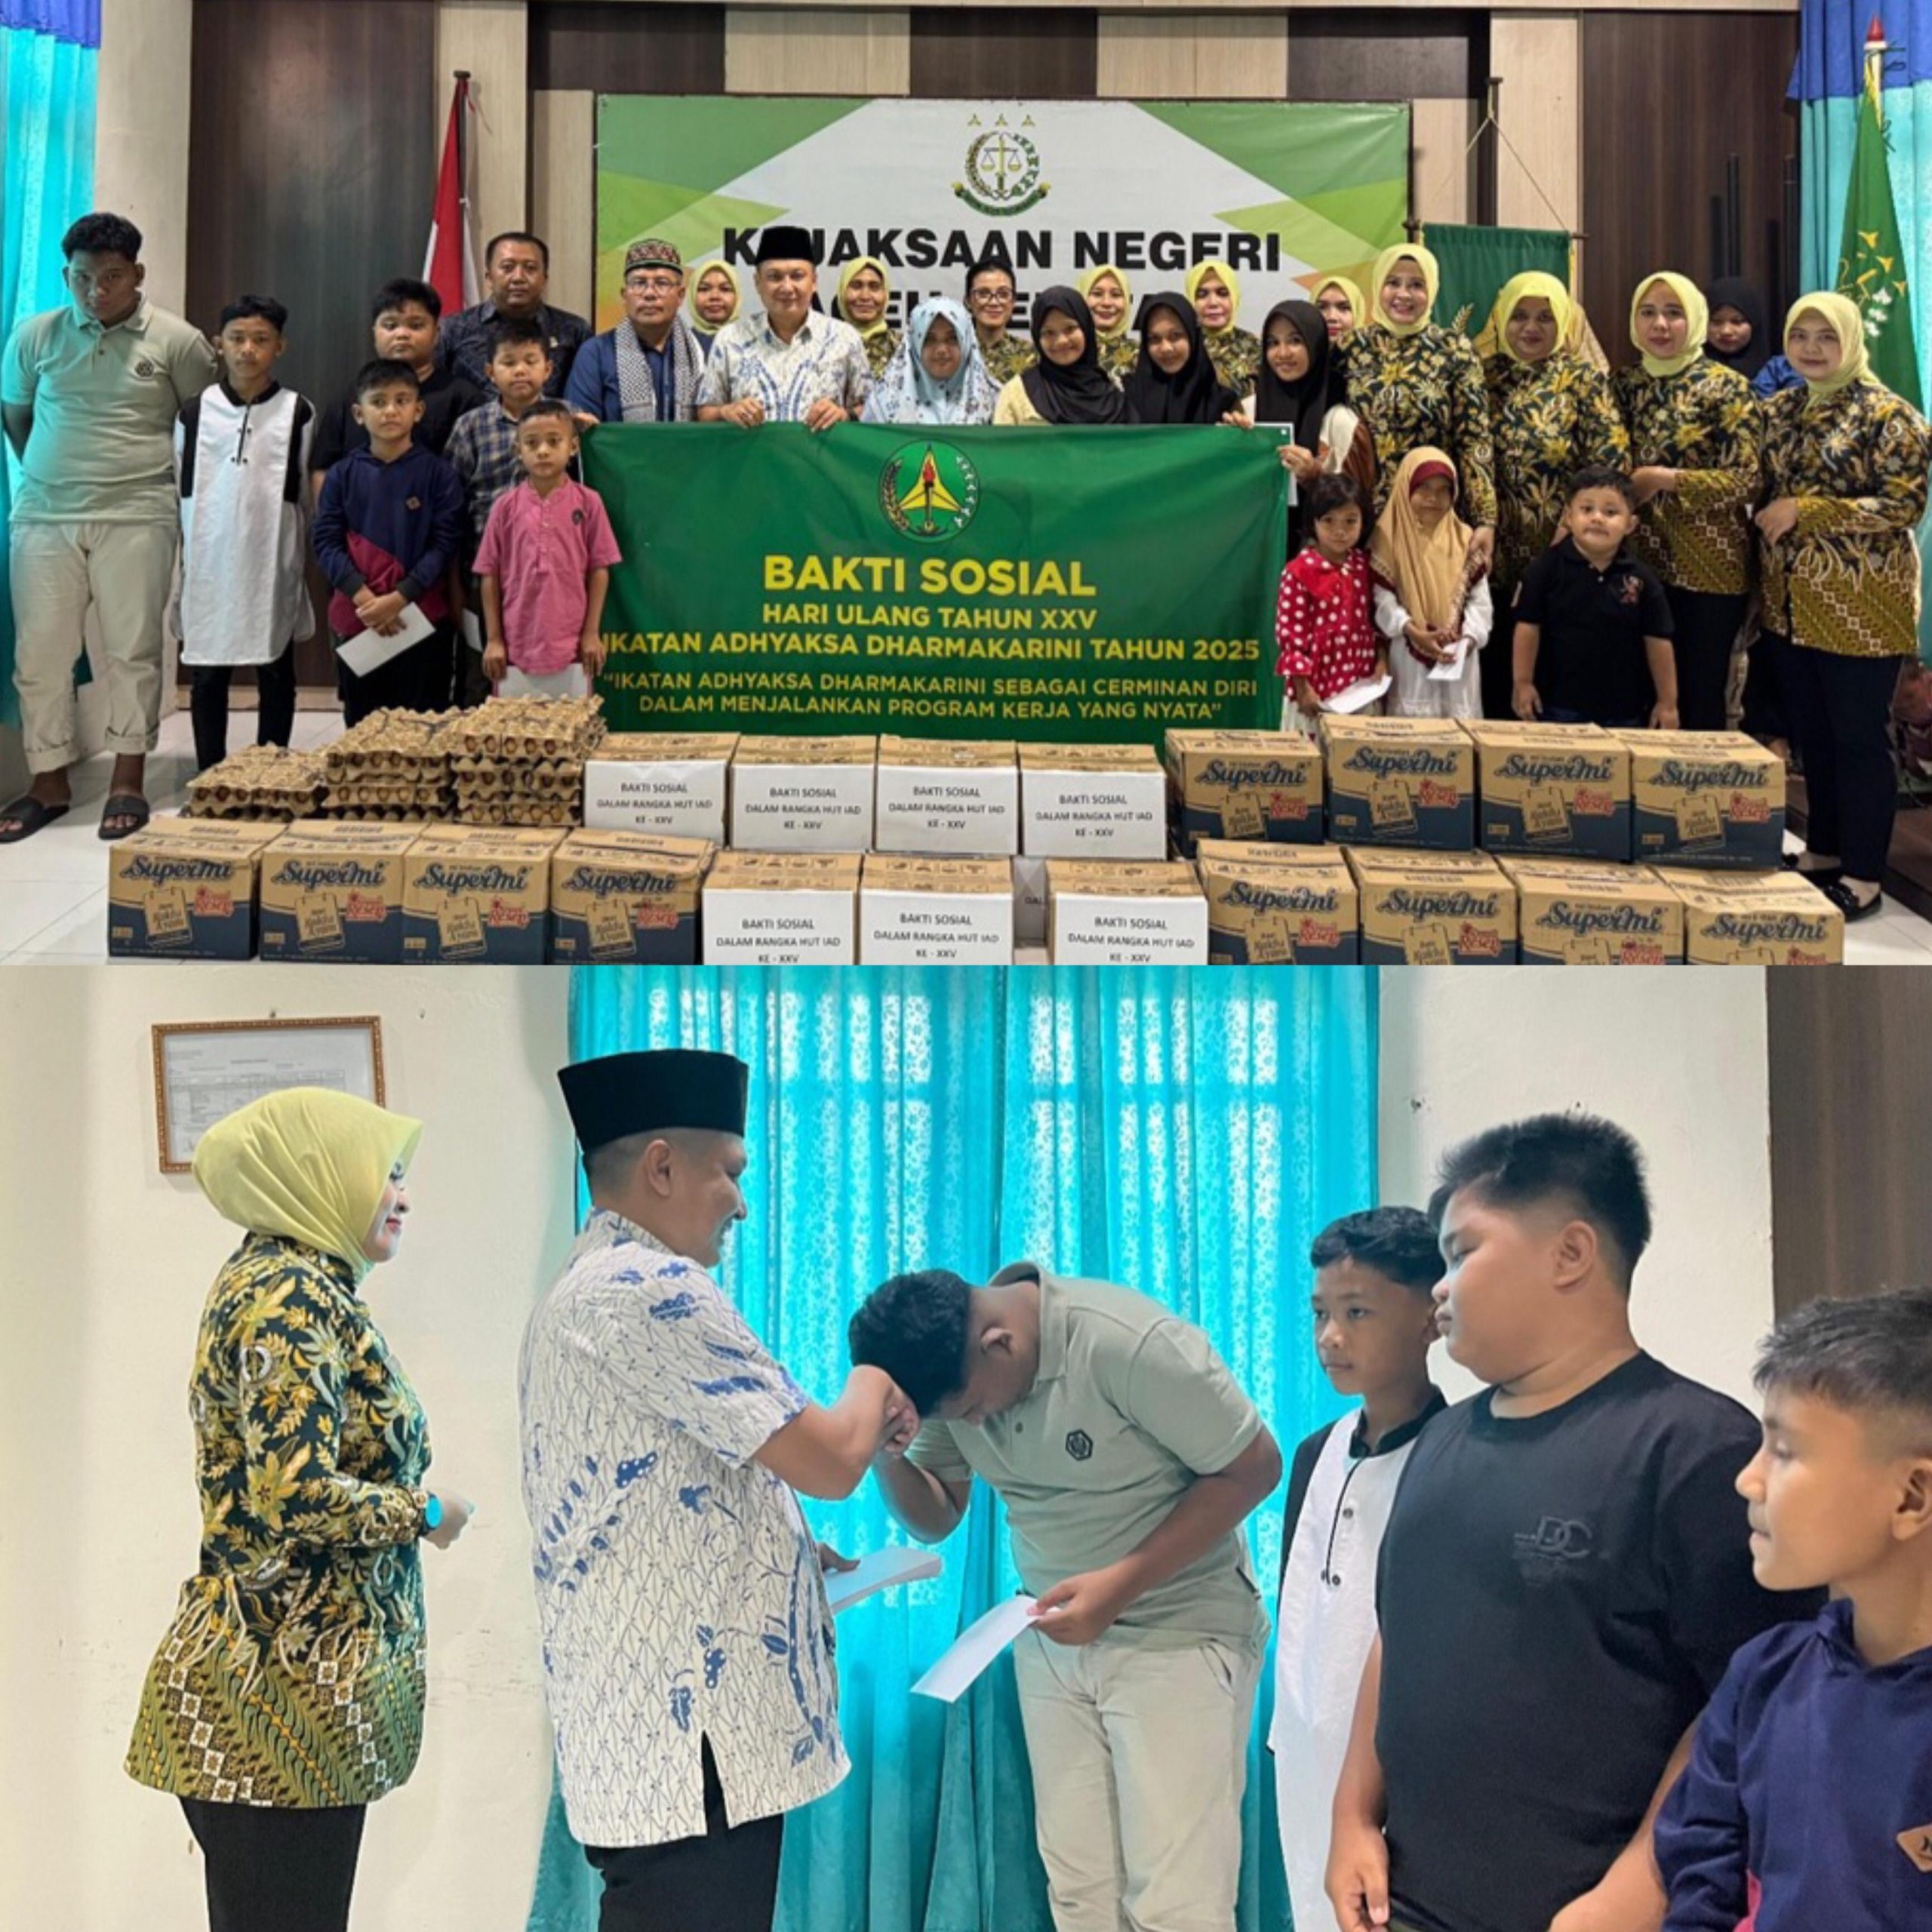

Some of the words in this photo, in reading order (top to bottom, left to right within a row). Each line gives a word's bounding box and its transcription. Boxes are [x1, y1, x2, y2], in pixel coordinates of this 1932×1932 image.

[724, 228, 1052, 268] KJAKSAAN
[1075, 231, 1280, 271] NEGERI
[764, 555, 905, 592] BAKTI
[919, 558, 1097, 596] SOSIAL
[763, 603, 828, 624] HARI
[837, 605, 930, 628] ULANG
[938, 608, 1032, 629] TAHUN
[1040, 609, 1097, 630] XXV
[603, 632, 701, 654] IKATAN
[709, 633, 858, 654] ADHYAKSA
[866, 636, 1081, 660] DHARMAKARINI
[1091, 639, 1185, 660] TAHUN
[1192, 639, 1260, 660] 2025
[698, 673, 813, 691] ADHYAKSA
[820, 675, 985, 694] DHARMAKARINI
[992, 678, 1085, 696] SEBAGAI
[1094, 678, 1207, 697] CERMINAN
[1215, 680, 1257, 697] DIRI
[639, 696, 713, 712] DALAM
[721, 696, 881, 715] MENJALANKAN
[888, 700, 995, 717] PROGRAM
[1002, 702, 1070, 718] KERJA
[1077, 702, 1135, 718] YANG
[621, 783, 650, 792] BAKTI
[654, 783, 688, 793] SOSIAL
[770, 788, 799, 798] BAKTI
[802, 789, 836, 798] SOSIAL
[913, 787, 942, 796] BAKTI
[946, 787, 980, 797] SOSIAL
[696, 800, 712, 808] IAD
[1059, 795, 1089, 804] BAKTI
[1092, 795, 1127, 804] SOSIAL
[746, 804, 778, 813] DALAM
[844, 806, 861, 814] IAD
[888, 804, 922, 812] DALAM
[925, 804, 964, 813] RANGKA
[1036, 812, 1069, 820] DALAM
[1137, 812, 1152, 820] IAD
[784, 820, 794, 829] KE
[804, 821, 821, 829] XXV
[928, 820, 937, 828] KE
[948, 820, 965, 829] XXV
[900, 913, 931, 924] BAKTI
[936, 915, 971, 924] SOSIAL
[1095, 917, 1126, 928] BAKTI
[1131, 918, 1167, 930] SOSIAL
[742, 918, 774, 930] BAKTI
[777, 919, 814, 930] SOSIAL
[716, 937, 752, 946] DALAM
[755, 938, 796, 946] RANGKA
[800, 938, 819, 946] HUT
[823, 938, 840, 946] IAD
[874, 931, 910, 940] DALAM
[982, 934, 998, 943] IAD
[1069, 934, 1103, 944] DALAM
[1107, 936, 1149, 946] RANGKA
[1177, 940, 1194, 949] IAD
[758, 955, 770, 963] KE
